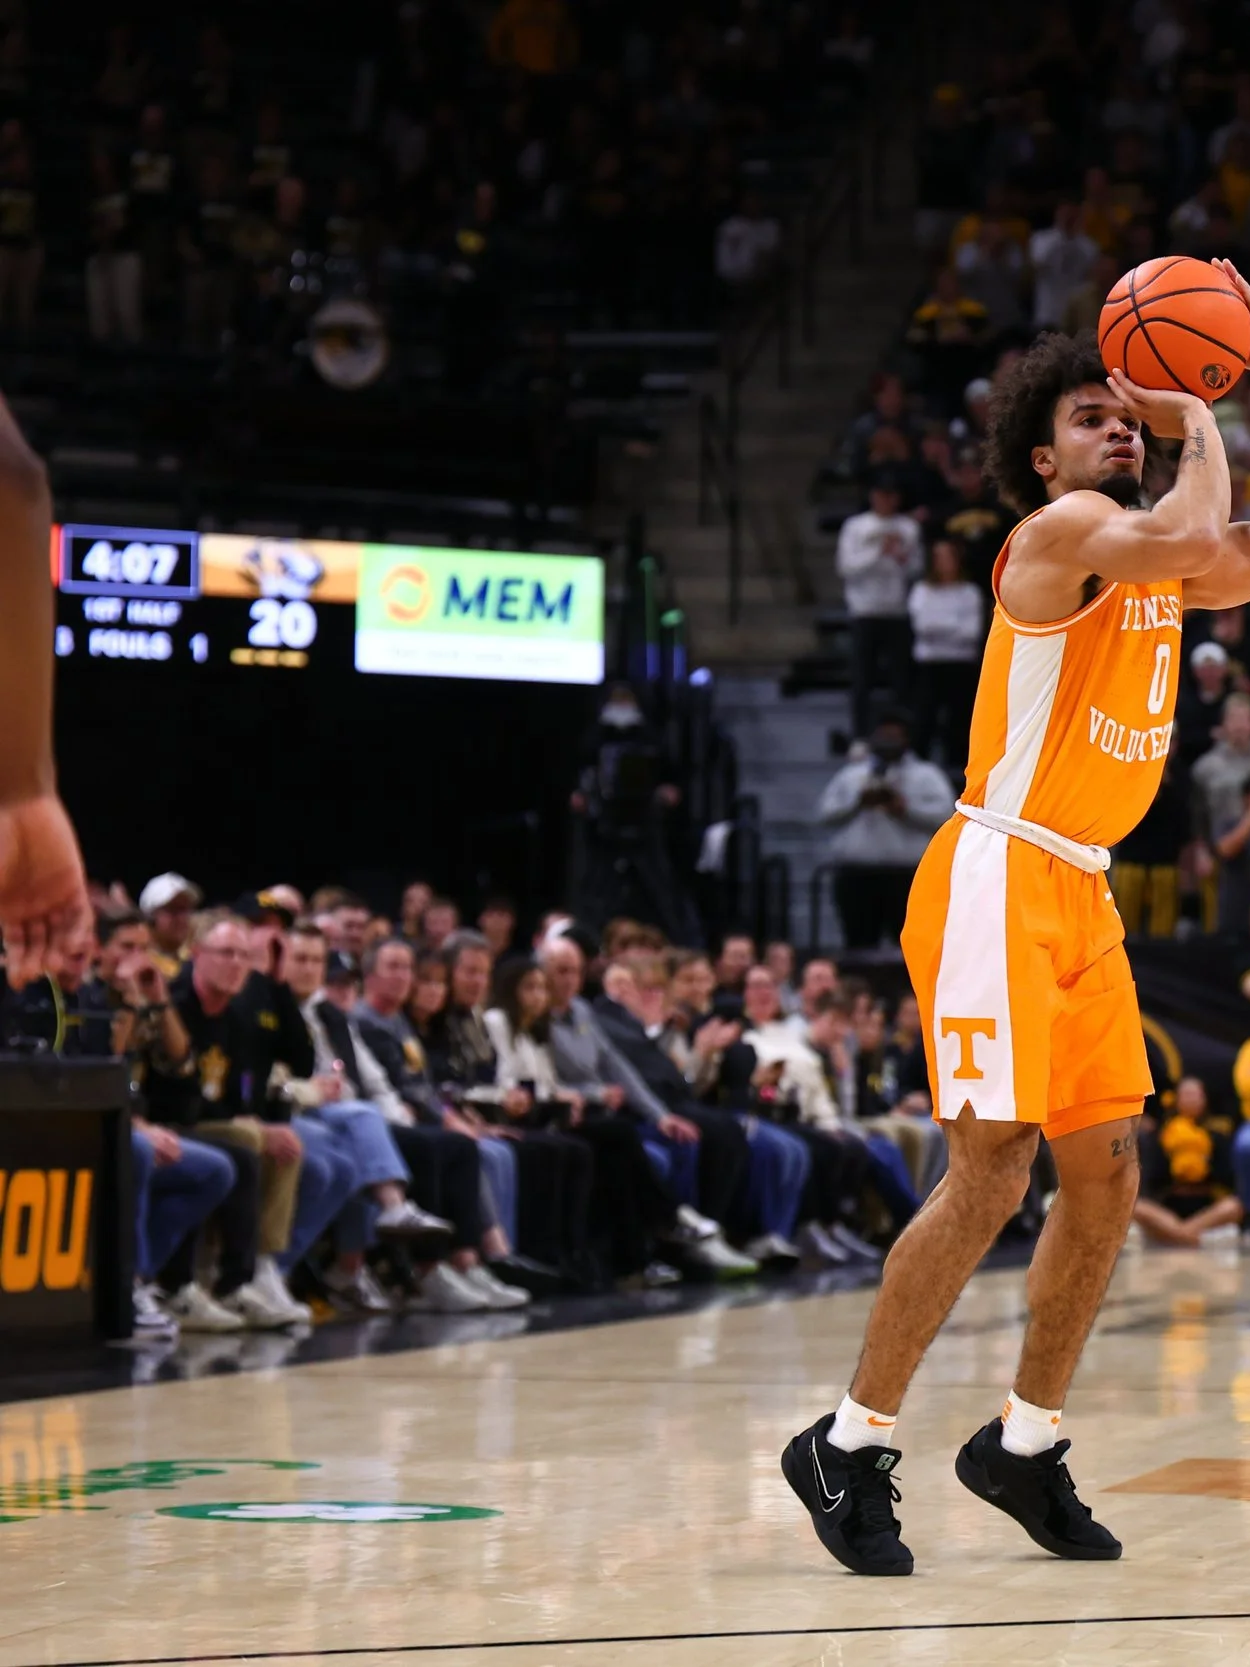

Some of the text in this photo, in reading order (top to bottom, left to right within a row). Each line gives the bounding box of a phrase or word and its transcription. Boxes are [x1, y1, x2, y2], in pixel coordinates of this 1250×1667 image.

[82, 540, 179, 585] 4:07
[248, 597, 317, 649] 20
[443, 575, 573, 623] MEM
[89, 628, 172, 661] FOULS
[1147, 643, 1171, 714] 0
[941, 1017, 996, 1079] T
